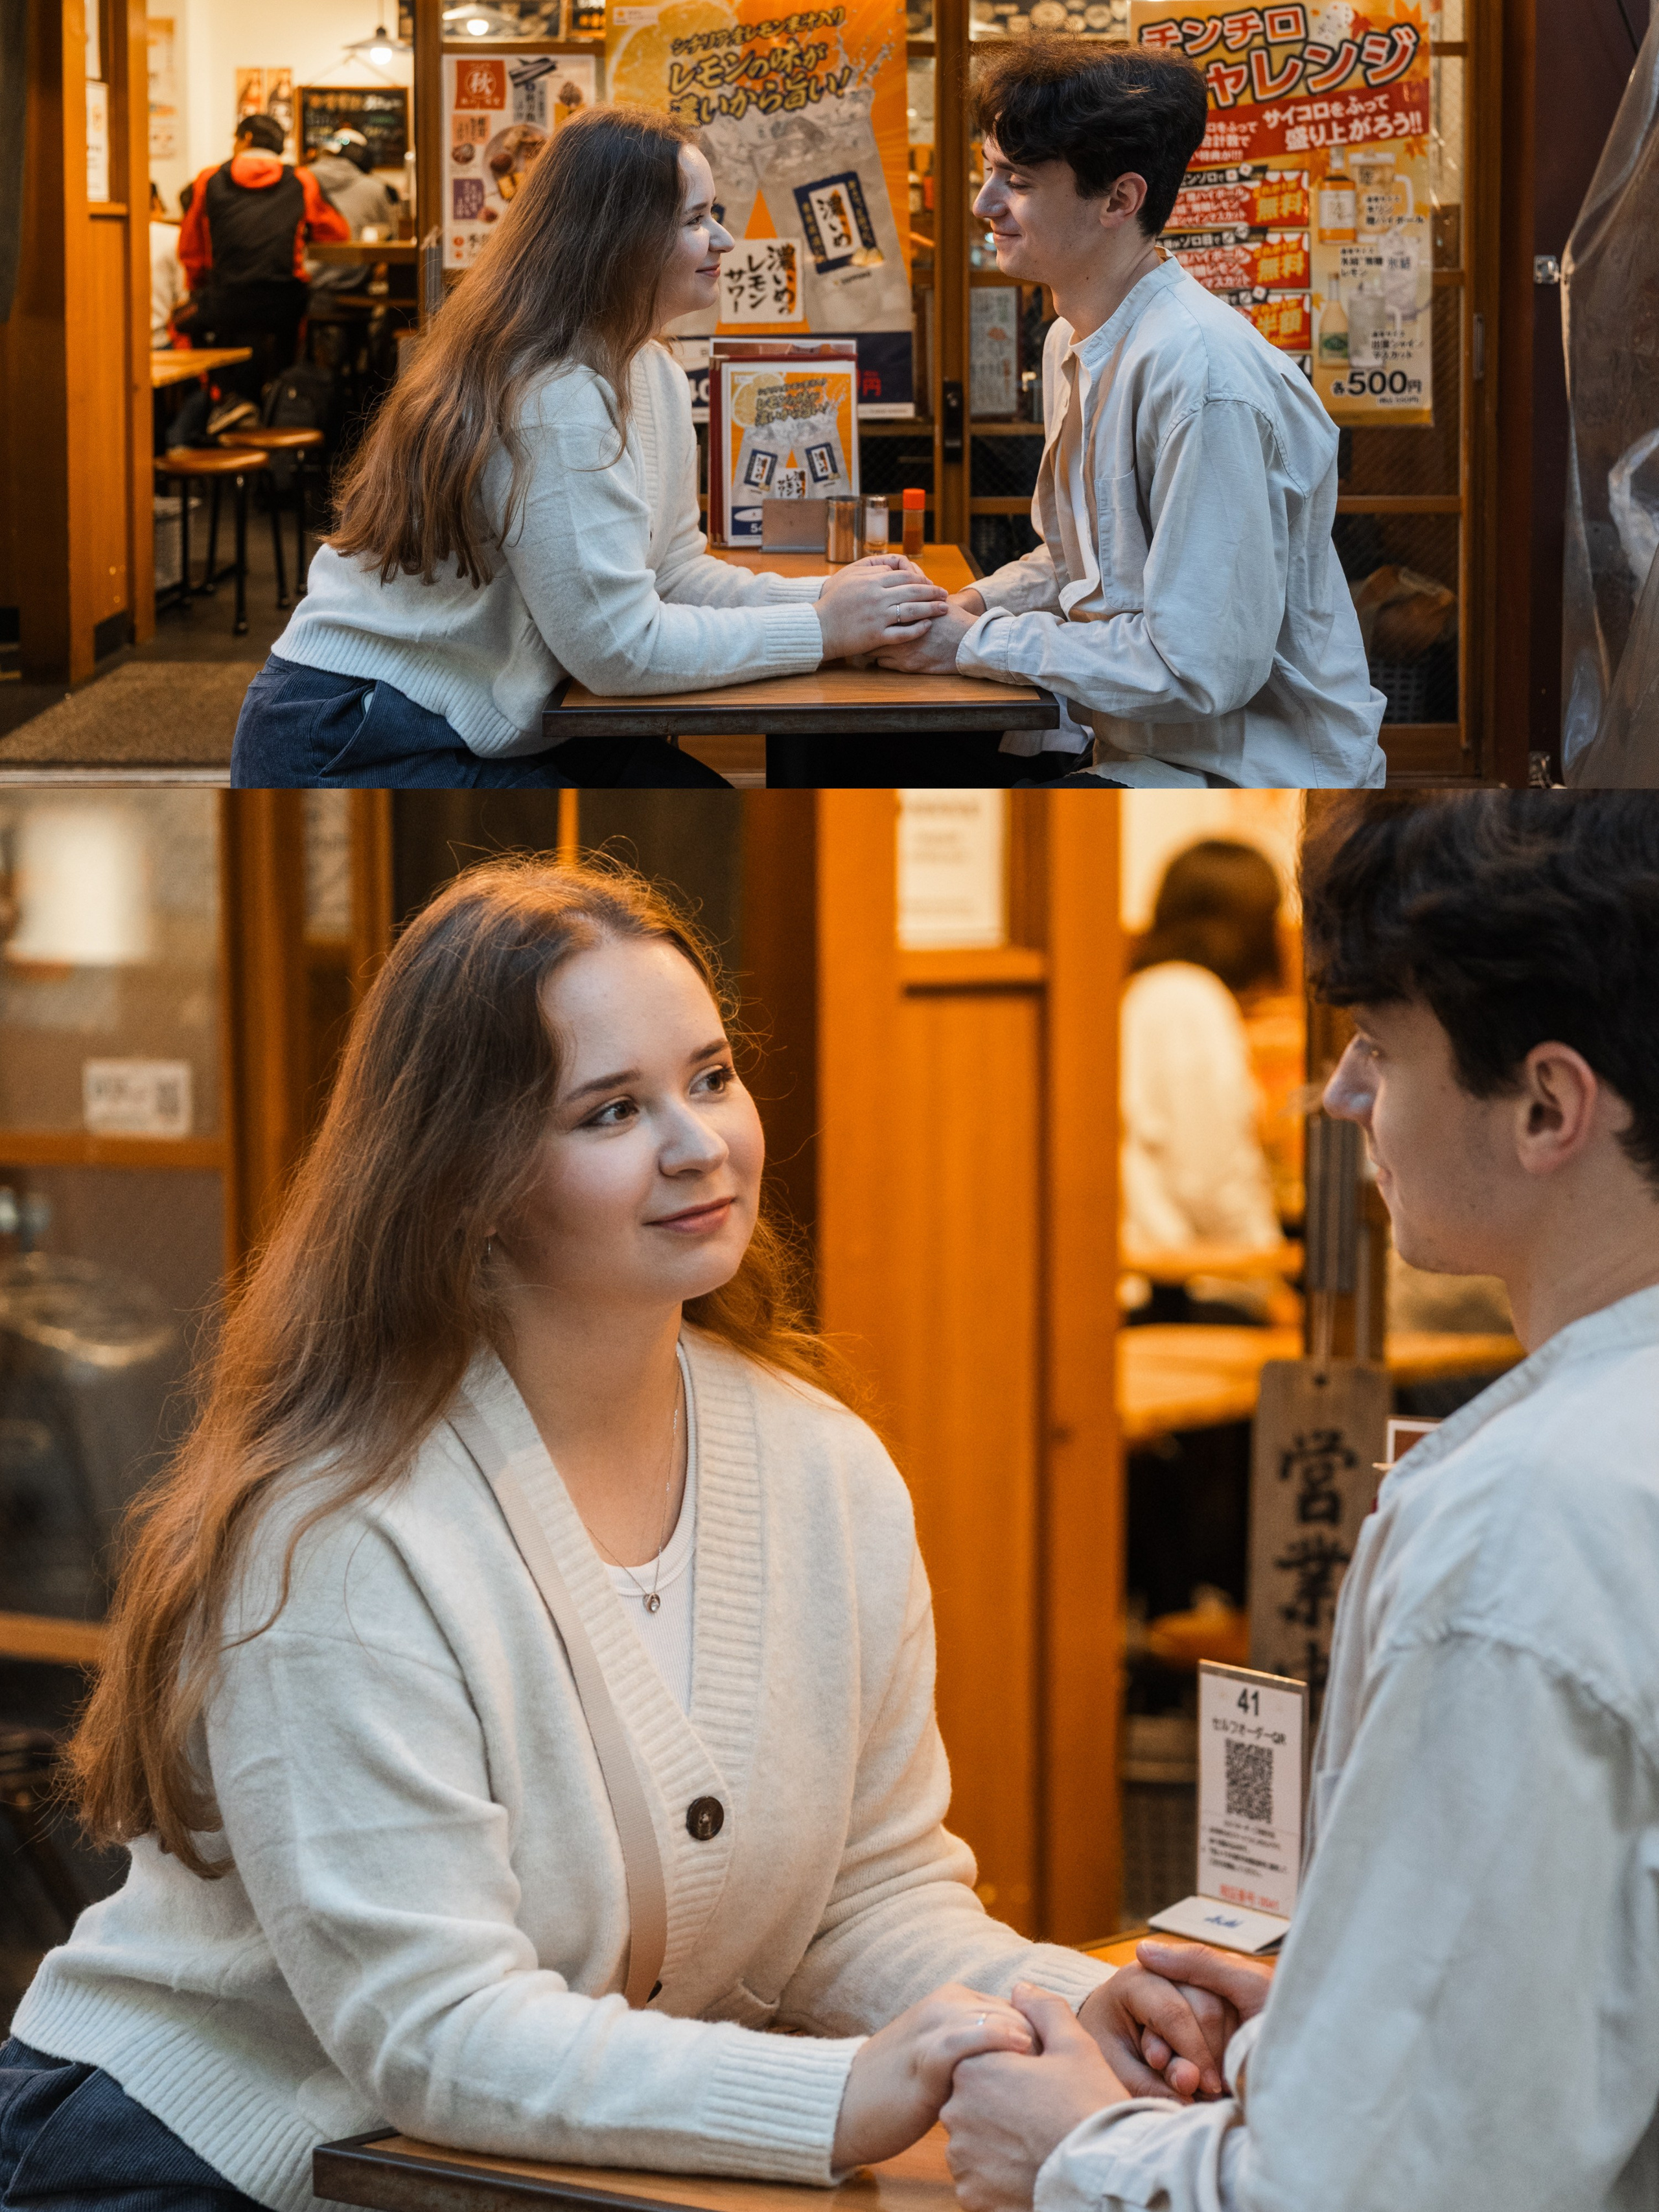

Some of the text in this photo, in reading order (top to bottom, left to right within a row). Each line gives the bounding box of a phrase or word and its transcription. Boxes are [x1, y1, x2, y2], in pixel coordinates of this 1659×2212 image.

[1139, 4, 1306, 57] チンチロ
[669, 37, 828, 94] レモンの味が
[1263, 94, 1389, 129] サイコロをふって
[1284, 111, 1423, 152] 盛り上がろう!!
[725, 268, 745, 313] サワー
[748, 255, 767, 309] レモン
[1237, 1688, 1259, 1716] 41
[1212, 1718, 1286, 1745] セルフオーダーQR
